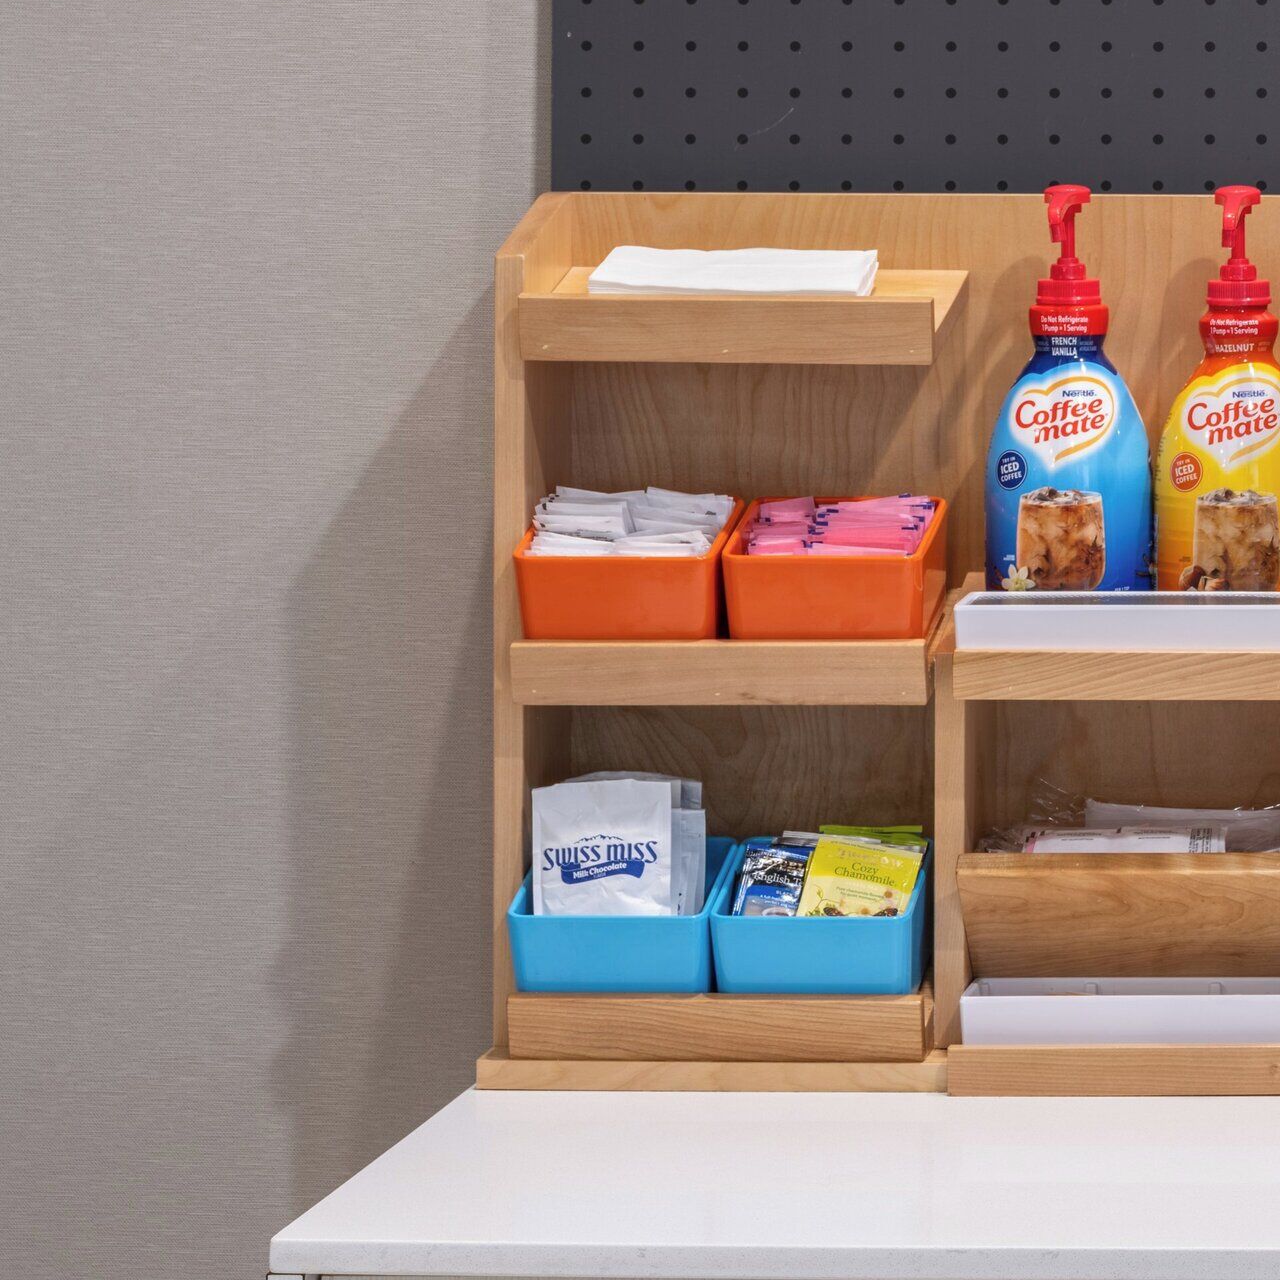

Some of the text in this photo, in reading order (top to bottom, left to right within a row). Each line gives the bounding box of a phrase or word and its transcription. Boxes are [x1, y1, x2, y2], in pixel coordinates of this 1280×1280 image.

[1058, 315, 1088, 324] Refrigerate
[1226, 319, 1259, 327] Refrigerate
[1045, 325, 1058, 333] Pump
[1067, 325, 1087, 333] Serving
[1213, 327, 1226, 335] Pump
[1234, 327, 1258, 335] Serving
[1051, 337, 1077, 345] FRENCH
[1052, 347, 1077, 356] VANILLA
[1215, 344, 1254, 352] HAZELNUT
[1015, 398, 1103, 429] Coffee
[1187, 398, 1274, 430] Coffee
[1034, 414, 1105, 444] mate
[1208, 414, 1277, 445] mate
[1001, 461, 1019, 474] ICED
[1175, 464, 1194, 477] ICED
[1001, 471, 1022, 482] COFFEE
[1176, 473, 1198, 484] COFFEE
[542, 845, 600, 871] SWISS
[590, 862, 627, 876] Chocolate
[852, 862, 879, 875] Cozy
[753, 871, 790, 884] English
